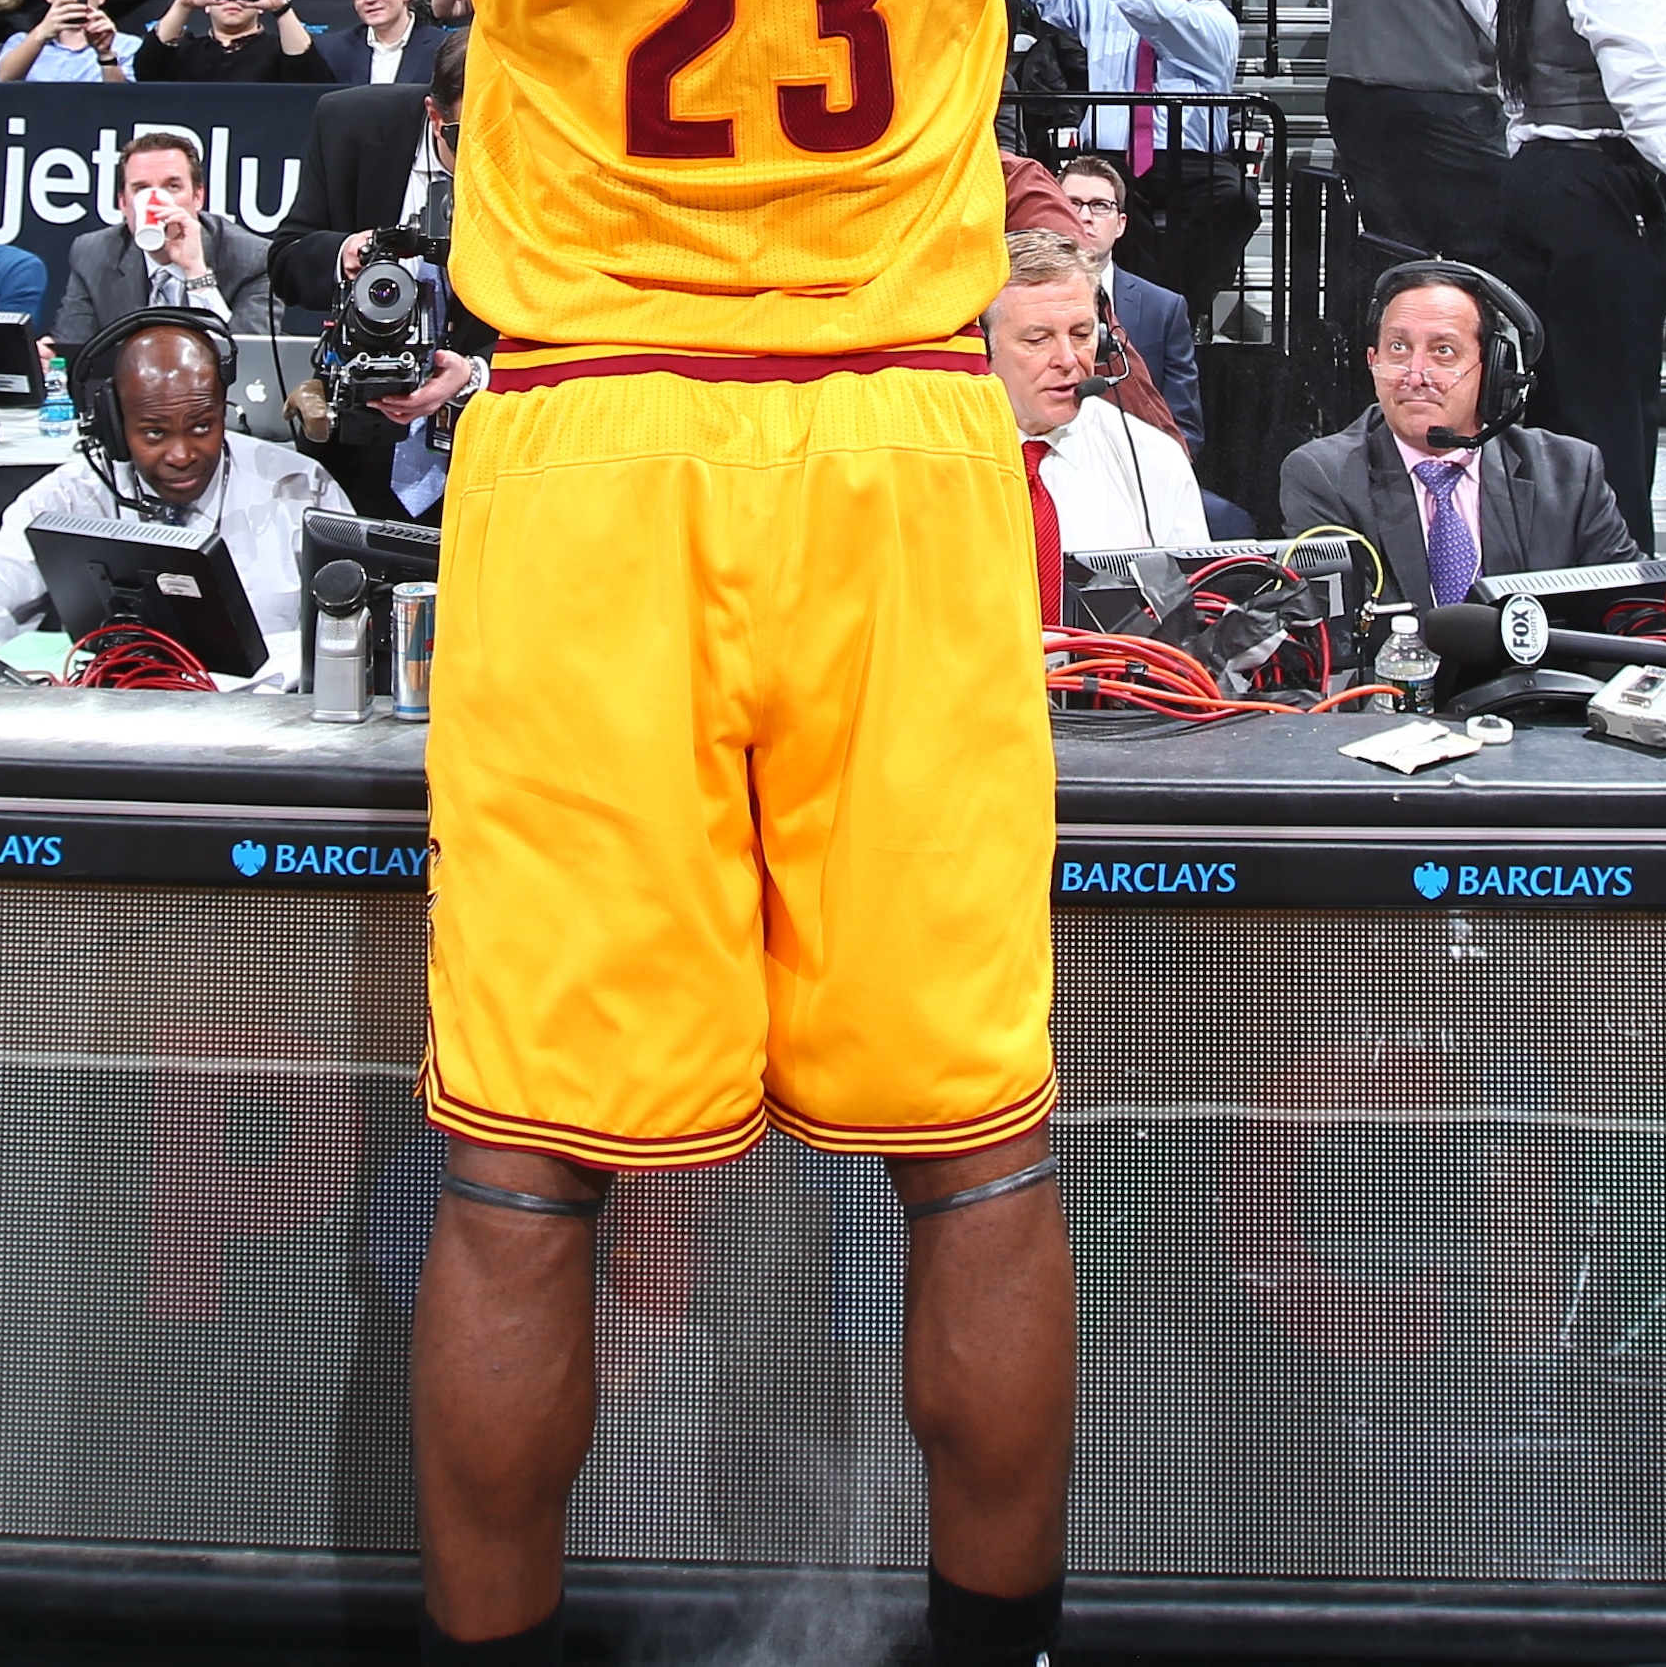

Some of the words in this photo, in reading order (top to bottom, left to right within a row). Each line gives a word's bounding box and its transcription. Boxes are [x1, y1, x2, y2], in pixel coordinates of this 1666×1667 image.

[1512, 608, 1530, 650] FOX
[1530, 607, 1539, 650] SPORTS
[273, 843, 429, 878] BARCLAY
[1060, 861, 1238, 894] BARCLAYS
[1456, 863, 1634, 898] BARCLAYS
